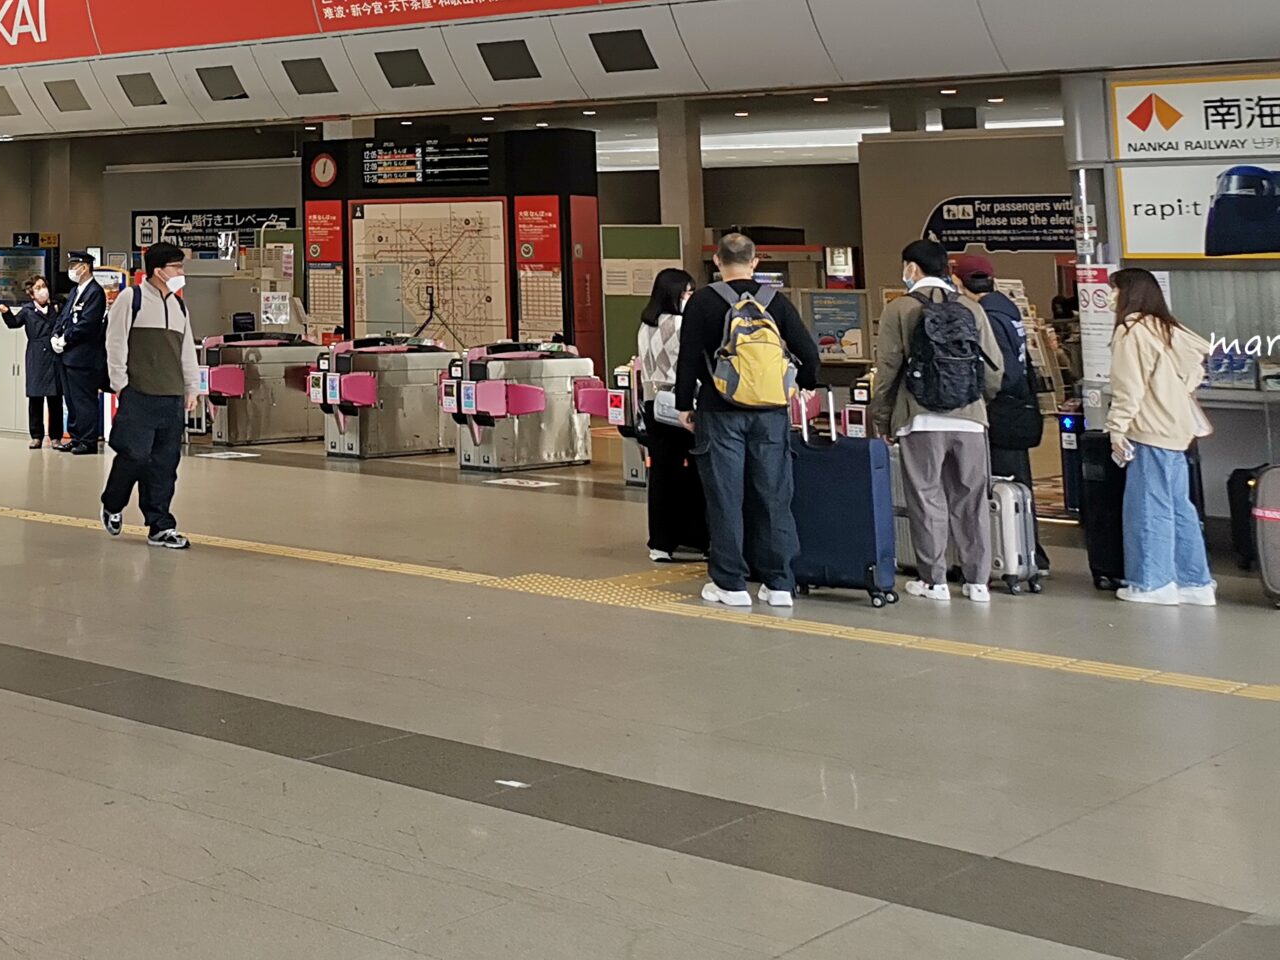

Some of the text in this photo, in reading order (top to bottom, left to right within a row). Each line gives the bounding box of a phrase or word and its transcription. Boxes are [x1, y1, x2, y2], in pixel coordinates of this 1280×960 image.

[1127, 139, 1247, 152] NANKAI RAILWAY
[974, 201, 990, 211] For
[994, 201, 1050, 214] passengers
[1133, 198, 1202, 220] rapi:t
[976, 215, 1007, 227] please
[1010, 217, 1027, 226] use
[1030, 215, 1047, 226] the
